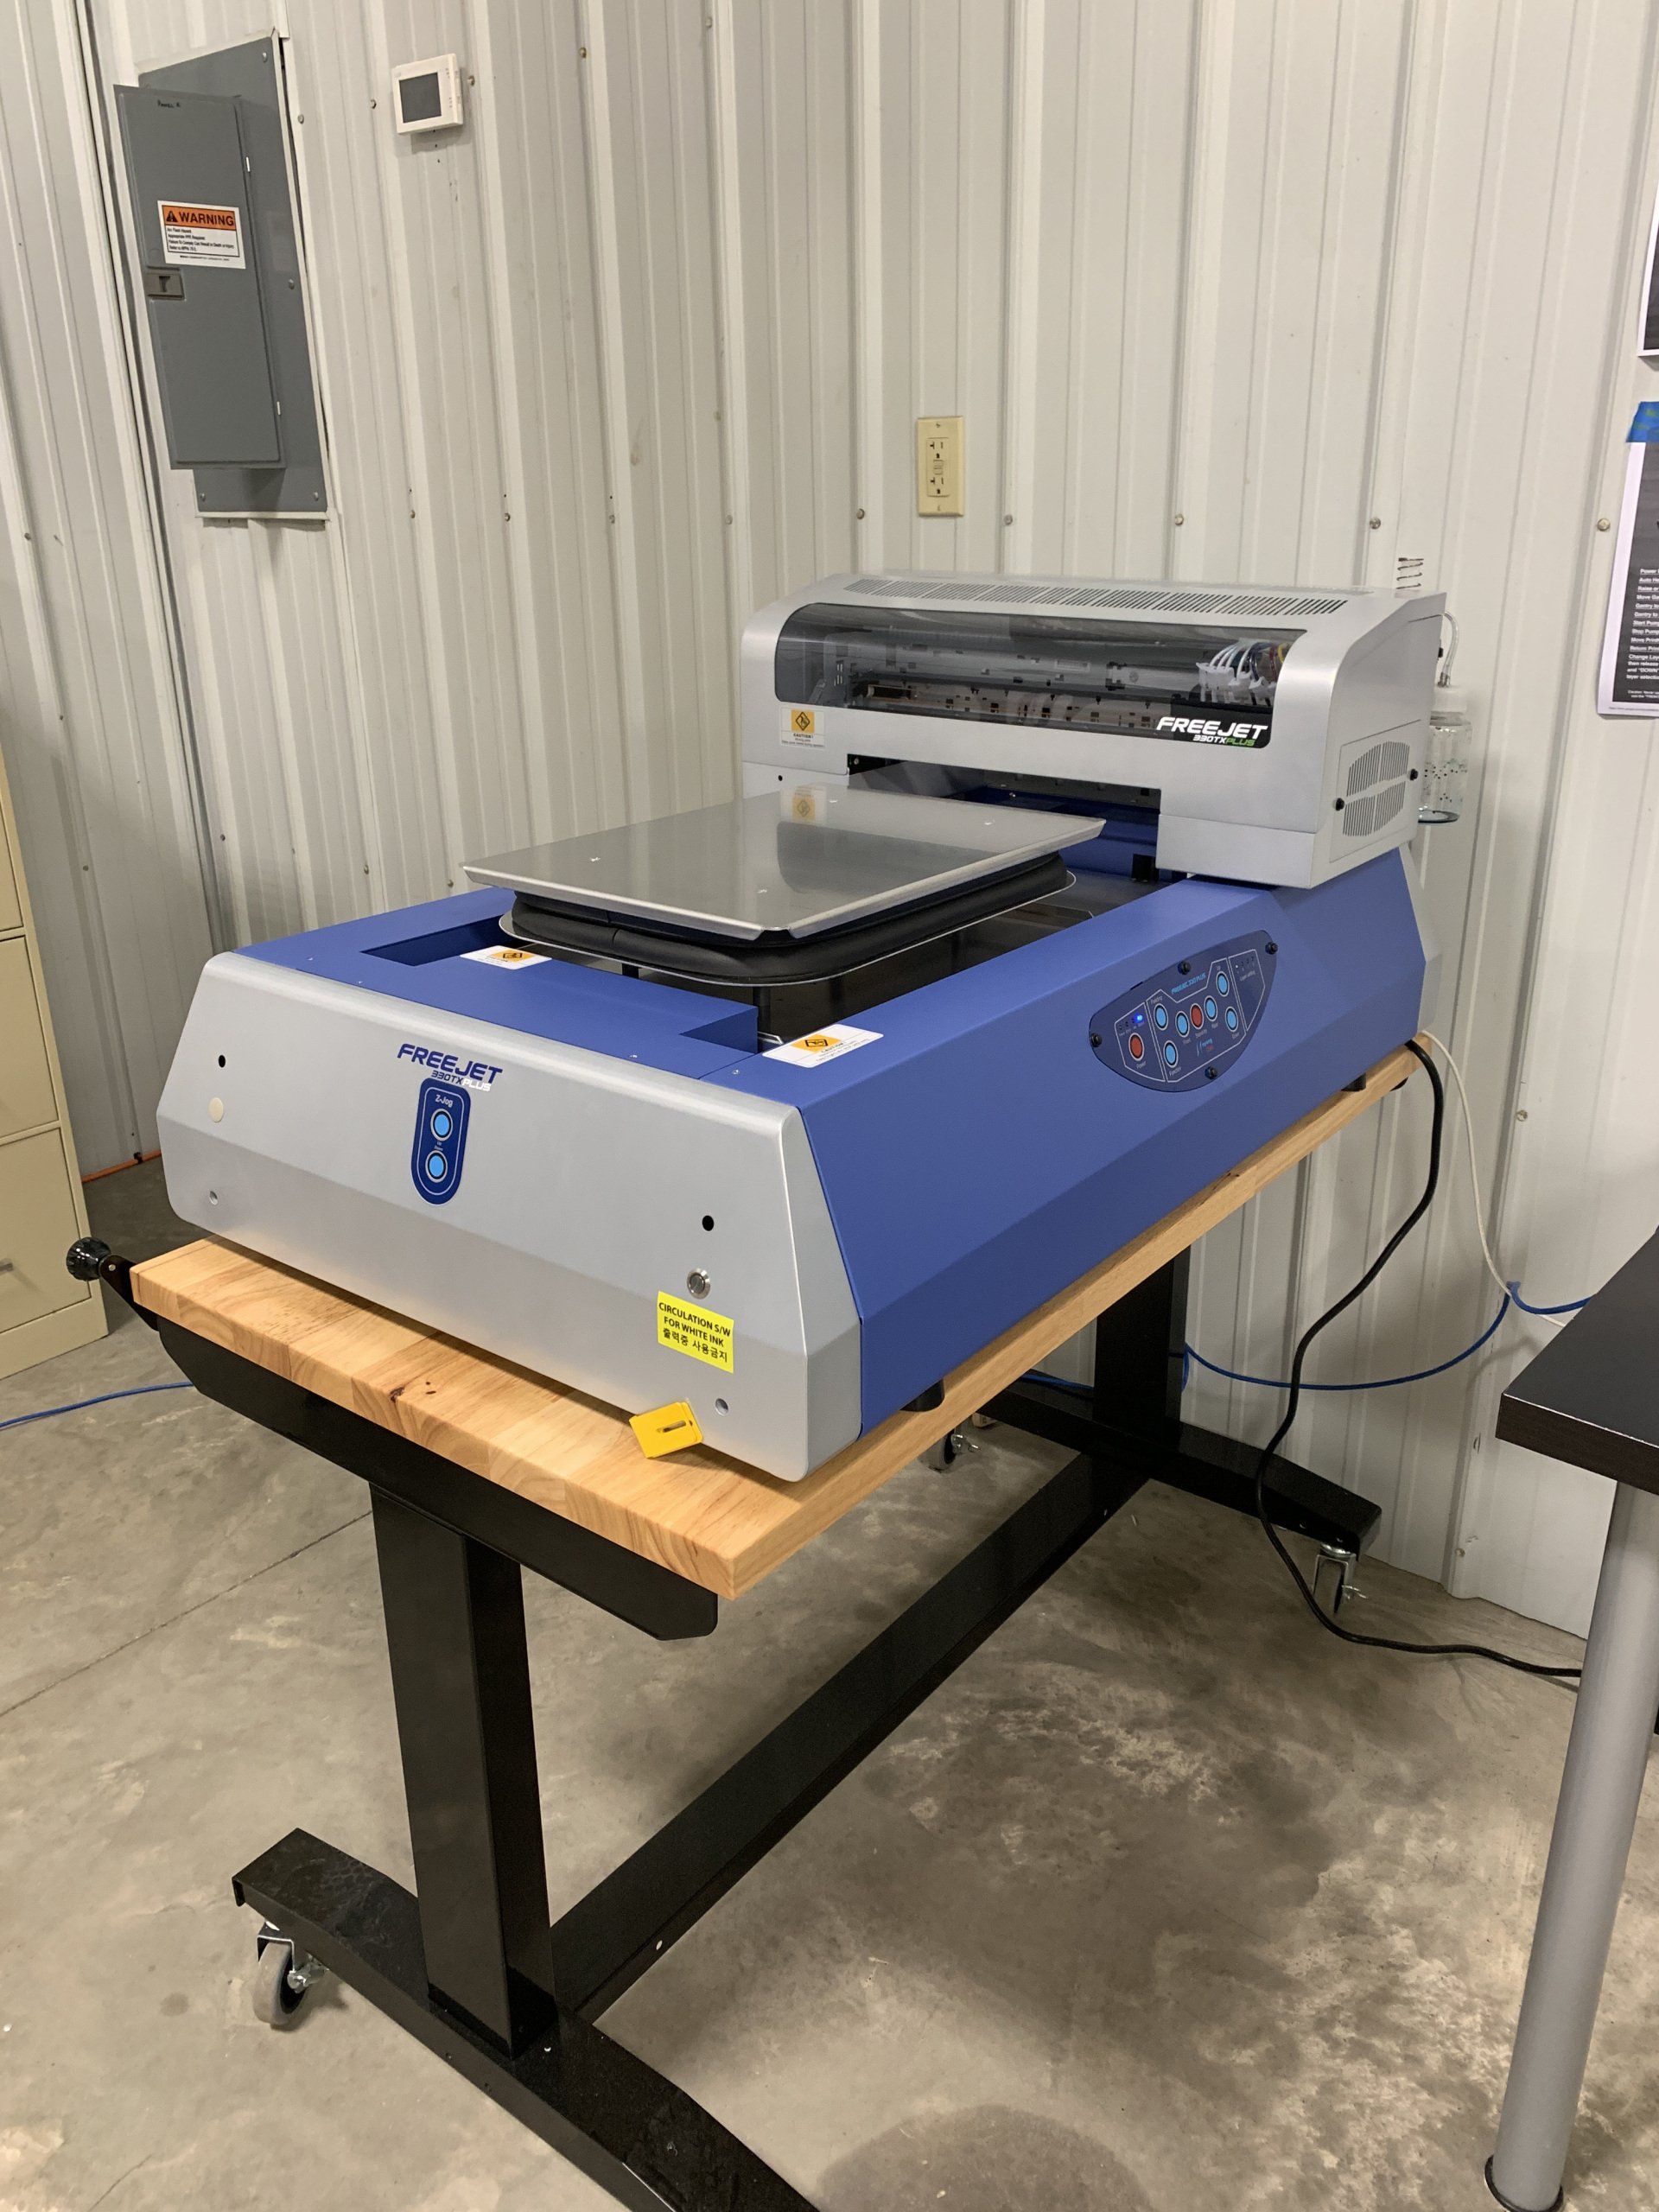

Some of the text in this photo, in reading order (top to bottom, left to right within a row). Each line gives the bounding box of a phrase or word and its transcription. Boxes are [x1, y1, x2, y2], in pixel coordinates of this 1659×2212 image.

[178, 211, 235, 226] WARNING
[1155, 716, 1269, 740] FREEJET
[397, 1043, 503, 1084] FREEJET
[658, 1302, 731, 1338] CIRCULATION S/W
[664, 1316, 724, 1348] FOR WHITE INK
[663, 1327, 728, 1363] 출력중 사용금지
